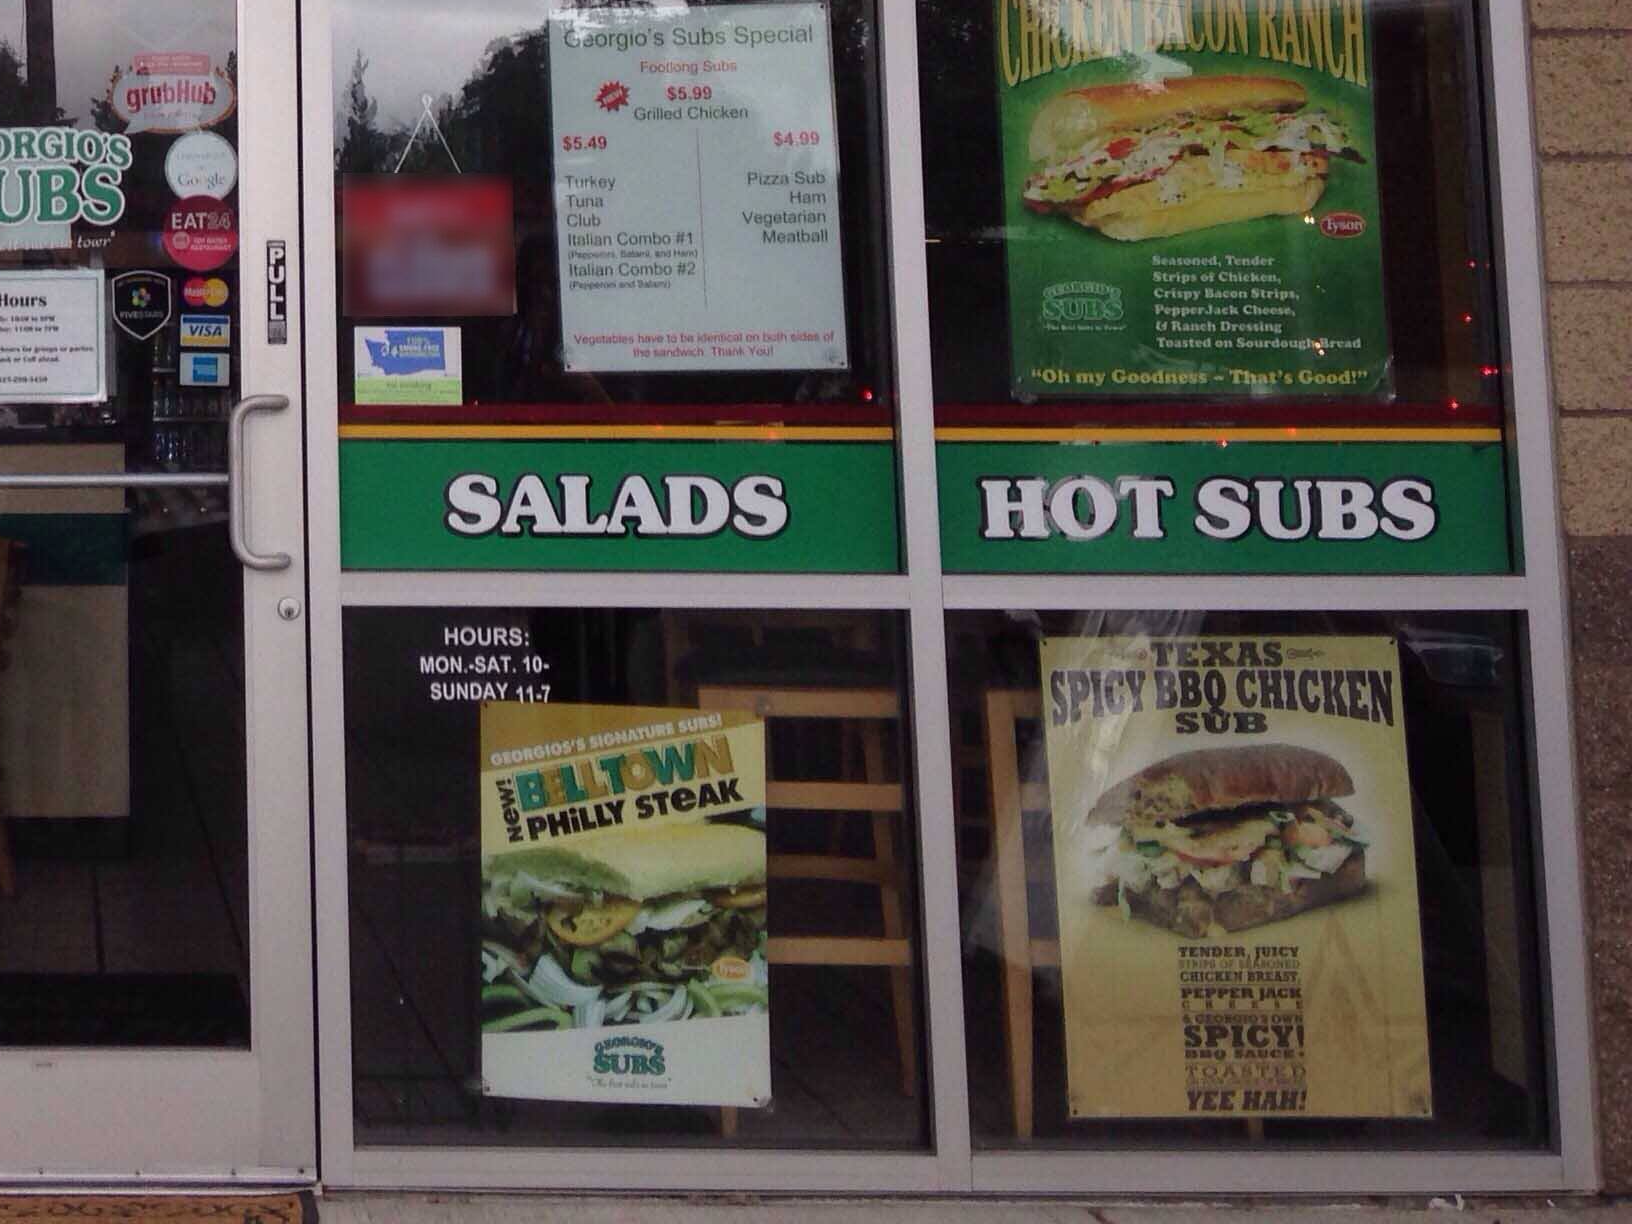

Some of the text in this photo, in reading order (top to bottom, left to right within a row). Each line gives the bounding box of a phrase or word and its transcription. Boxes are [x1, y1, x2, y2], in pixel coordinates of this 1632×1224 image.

[564, 25, 813, 51] Georgio's Subs Special
[640, 60, 737, 75] Footlong Subs
[667, 86, 712, 102] $5.99
[634, 105, 749, 121] Grilled Chicken
[562, 135, 607, 151] $5.49
[774, 131, 820, 146] $4.99
[565, 176, 616, 191] Turkey
[747, 171, 826, 186] Pizza Sub
[566, 195, 604, 209] Tuna
[789, 191, 827, 205] Ham
[566, 214, 601, 227] Club
[742, 210, 827, 228] Vegetarian
[568, 232, 693, 246] Italian Combo #1
[762, 229, 828, 244] Meatball
[1152, 255, 1275, 267] Seasoned, Tender
[569, 262, 696, 277] Italian Combo #2
[269, 247, 285, 320] PULL
[1152, 271, 1281, 284] Strips of Chicken,
[1154, 288, 1300, 300] Crispy Bacon Strips,
[1242, 304, 1296, 316] Cheese,
[189, 325, 222, 337] VISA
[1171, 321, 1216, 332] Ranch
[1220, 321, 1282, 334] Dressing
[573, 333, 634, 346] Vegetables
[638, 333, 664, 344] have
[1156, 337, 1211, 349] Toasted
[1215, 340, 1233, 349] on
[1319, 337, 1361, 349] Bread
[1076, 371, 1106, 387] my
[1111, 368, 1209, 384] Goodness
[1229, 369, 1293, 384] That's
[446, 474, 789, 537] SALADS
[980, 477, 1436, 540] HOT SUBS
[444, 627, 530, 647] HOURS:
[1150, 641, 1283, 668] TEXAS
[419, 656, 517, 674] MON.-SAT.
[430, 683, 551, 704] SUNDAY 11-7
[1050, 668, 1394, 727] SPICY BBQ CHICKEN
[1176, 712, 1269, 734] SUB
[590, 721, 674, 749] SIGNATURE
[678, 713, 722, 733] SUBS!
[514, 733, 736, 813] BELLTOWN
[1254, 946, 1299, 961] JUICY
[1180, 971, 1242, 982] CHICKEN
[1180, 987, 1302, 1001] PEPPER JACK
[1184, 1026, 1305, 1048] SPICY!
[593, 1051, 666, 1076] SUBS
[1187, 1090, 1237, 1111] YEE
